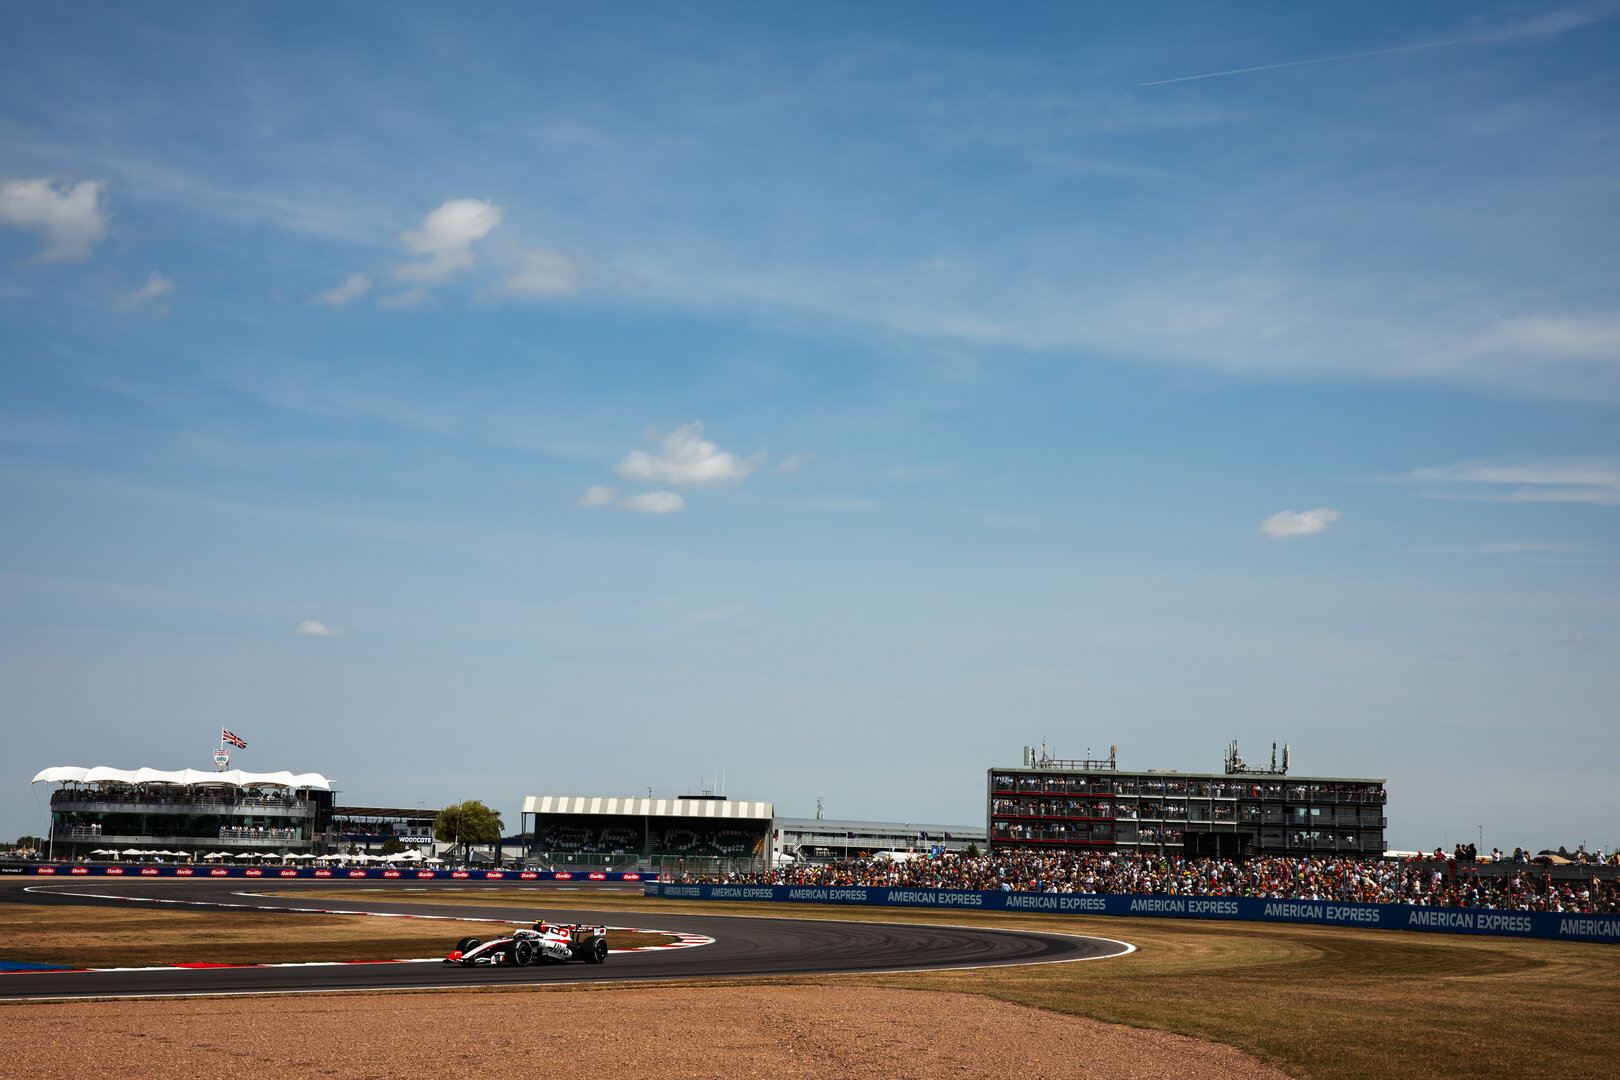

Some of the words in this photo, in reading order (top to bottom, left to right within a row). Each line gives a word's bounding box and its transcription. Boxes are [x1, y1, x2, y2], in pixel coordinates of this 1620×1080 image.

[398, 836, 432, 844] WOODCOTE
[711, 888, 742, 898] AMERICAN
[743, 888, 772, 898] EXPRESS
[789, 889, 828, 900] AMERICAN
[829, 890, 867, 901] EXPRESS
[888, 892, 936, 903] AMERICAN
[938, 893, 982, 905] EXPRESS
[1006, 895, 1057, 908] AMERICAN
[1060, 898, 1106, 910] EXPRESS
[1130, 899, 1185, 912] AMERICAN
[1188, 900, 1238, 914] EXPRESS
[1264, 904, 1322, 918] AMERICAN
[1326, 906, 1380, 922] EXPRESS
[1409, 911, 1474, 928] AMERICAN
[1477, 914, 1532, 932] EXPRESS
[1560, 918, 1620, 936] AMERICAN
